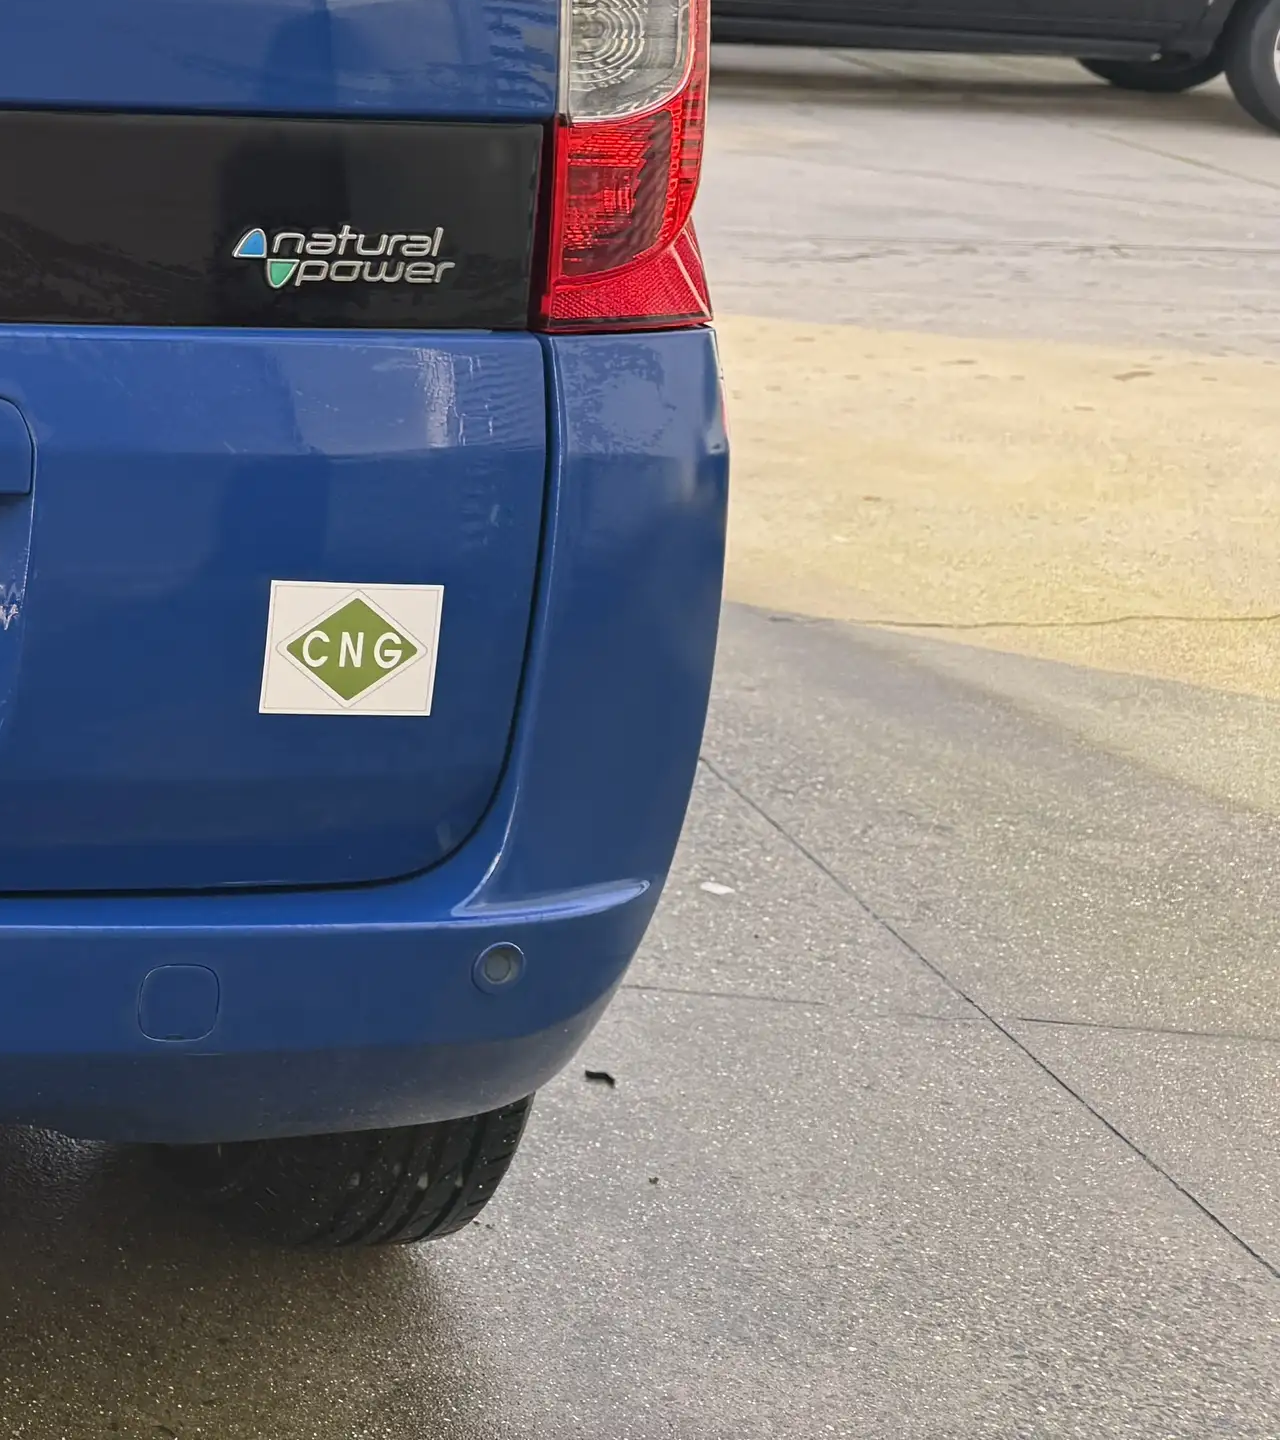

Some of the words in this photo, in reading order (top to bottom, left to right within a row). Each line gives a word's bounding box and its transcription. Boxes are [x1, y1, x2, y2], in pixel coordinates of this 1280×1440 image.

[272, 224, 445, 258] natural
[294, 259, 456, 287] power
[302, 629, 403, 669] CNG
